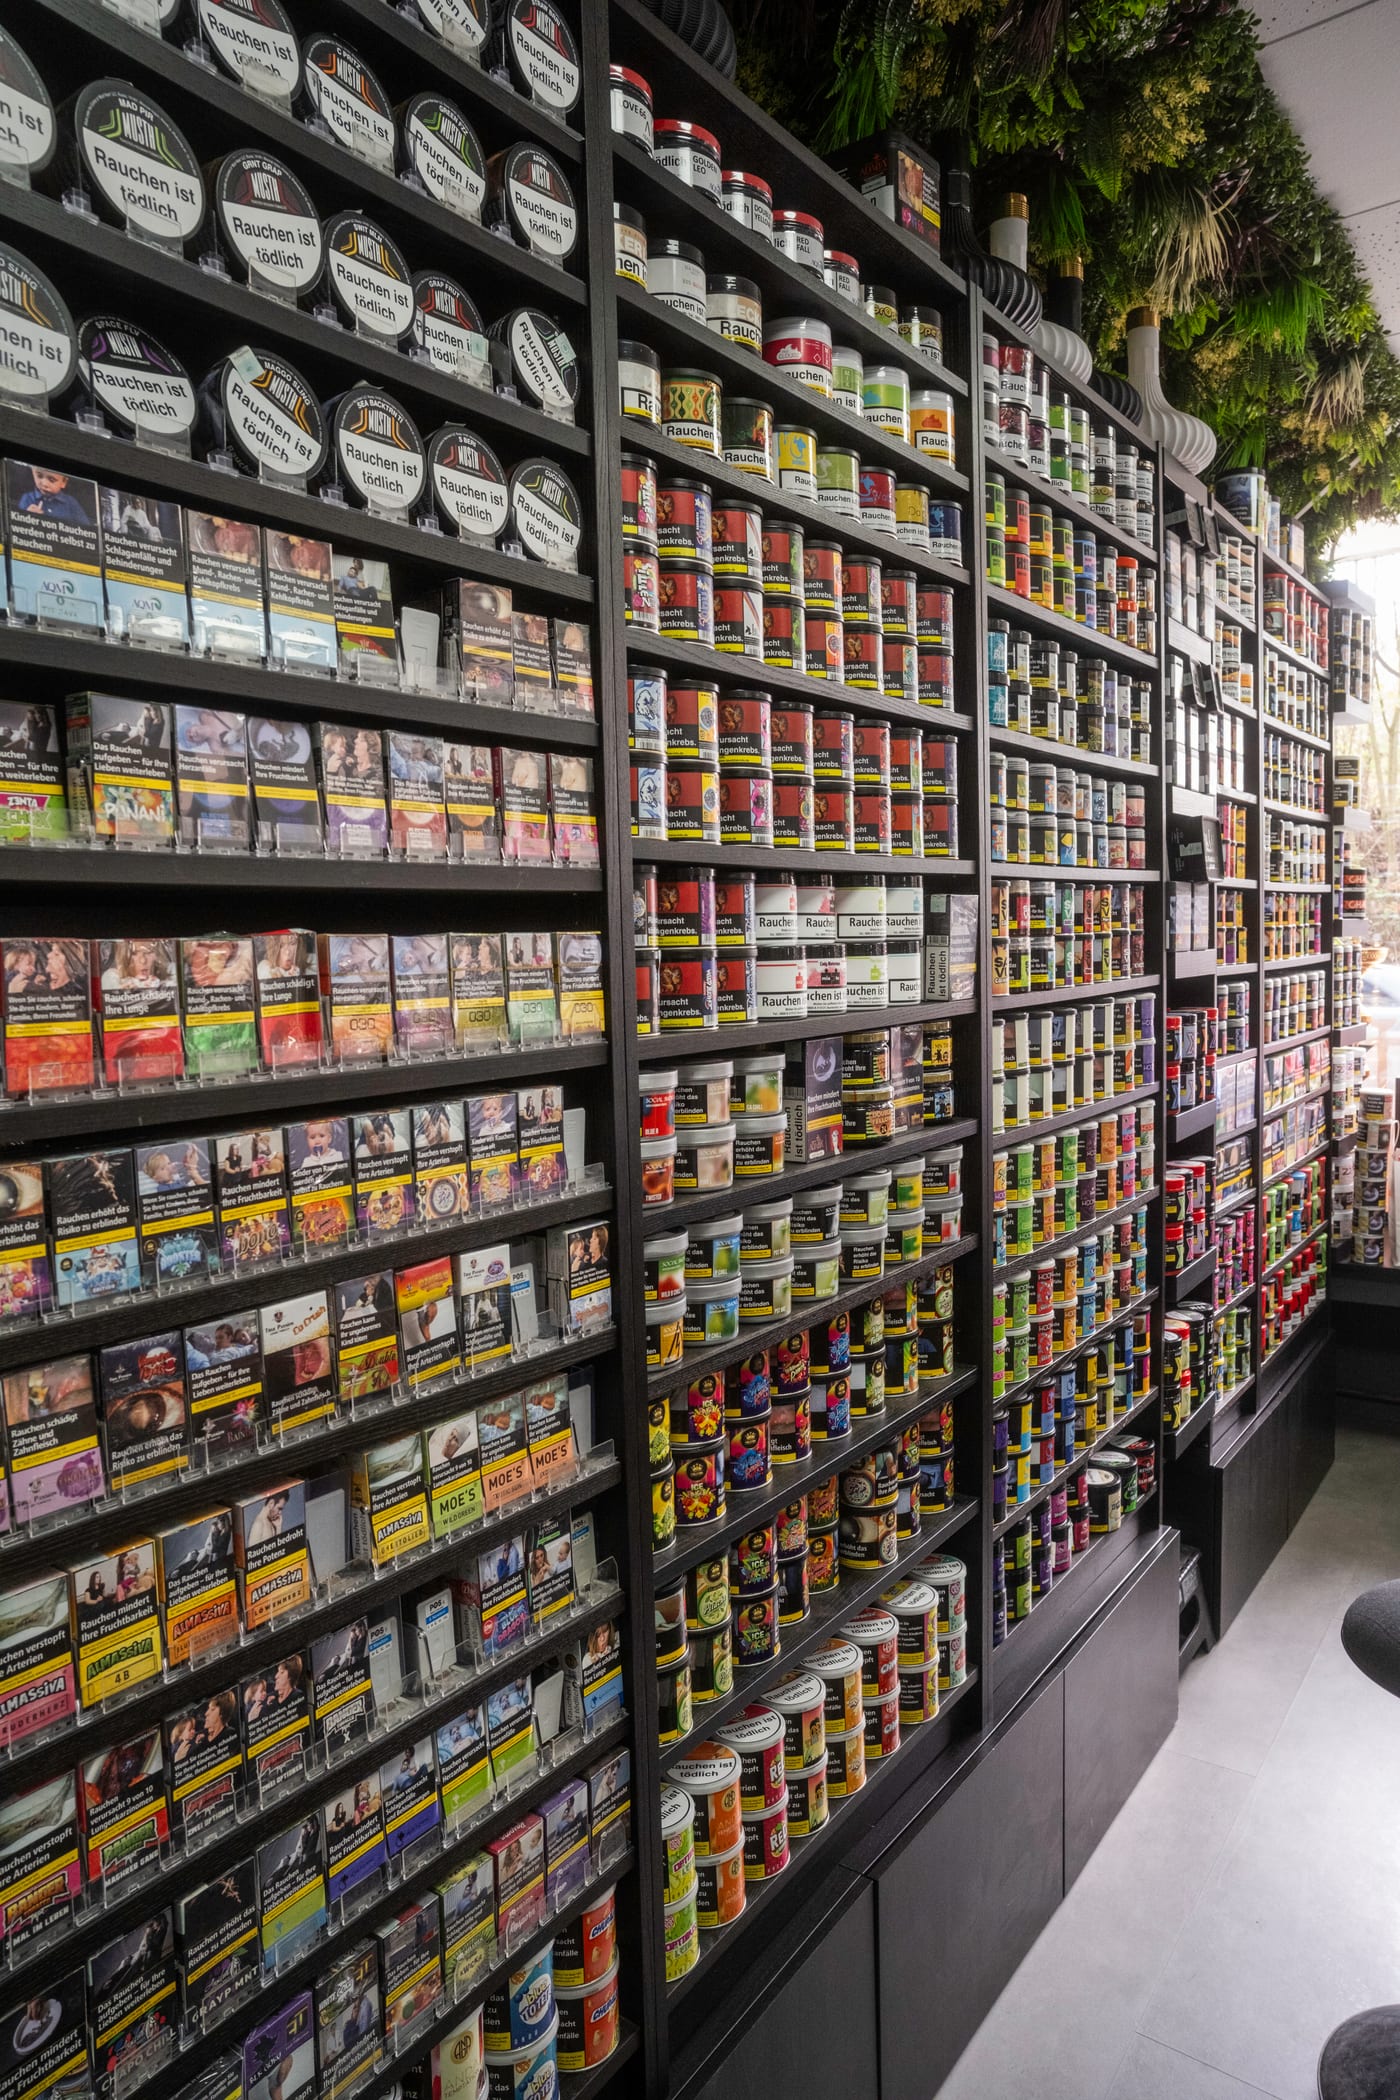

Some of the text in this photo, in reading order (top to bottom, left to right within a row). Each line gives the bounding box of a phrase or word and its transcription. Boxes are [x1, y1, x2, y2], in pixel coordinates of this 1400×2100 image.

[208, 13, 294, 62] Rauchen ist
[516, 31, 575, 88] Rauchen ist
[529, 63, 564, 97] tödlich
[118, 96, 138, 112] MAD
[18, 106, 44, 136] ist
[122, 112, 156, 150] MUSTH
[373, 122, 390, 142] ist
[416, 129, 480, 196] Rauchen ist
[692, 154, 718, 173] GOLDEN
[692, 165, 706, 175] LEO
[94, 146, 196, 206] Rauchen ist
[251, 172, 281, 202] MUSTH
[120, 184, 178, 222] tödlich
[514, 190, 572, 230] Rauchen ist
[232, 216, 316, 247] Rauchen ist
[528, 218, 562, 244] tödlich
[796, 236, 810, 246] RED
[256, 246, 304, 270] tödlich
[357, 231, 382, 264] MUSTH
[8, 263, 38, 291] SLING
[336, 262, 409, 308] Rauchen ist
[354, 294, 396, 322] tödlich
[434, 290, 456, 317] MUSTH
[96, 320, 122, 330] SPACE
[416, 320, 464, 349] Rauchen
[39, 338, 64, 364] ist
[106, 330, 143, 360] MUSTH
[519, 321, 552, 384] Rauchen
[518, 344, 546, 392] tödlich
[93, 368, 188, 398] Rauchen ist
[123, 395, 178, 418] tödlich
[268, 377, 300, 416] MUSTH
[232, 383, 292, 446] Rauchen
[296, 438, 313, 461] ist
[368, 410, 392, 437] MUSTH
[666, 426, 714, 442] Rauchen
[242, 416, 290, 464] tödlich
[346, 442, 418, 478] Rauchen ist
[458, 444, 480, 471] MUSTH
[362, 470, 404, 495] tödlich
[440, 476, 504, 508] Rauchen ist
[543, 478, 563, 506] MUSTH
[818, 494, 850, 504] Rauchen
[11, 511, 97, 539] Kinder von Rauchern
[456, 501, 492, 524] tödlich
[518, 494, 575, 546] Rauchen ist
[861, 512, 892, 522] Rauchen
[12, 524, 96, 550] werden oft selbst zu
[12, 536, 52, 552] Rauchern
[104, 534, 177, 557] Rauchen verursacht
[105, 545, 156, 565] Schlaganfälle
[157, 556, 172, 566] und
[106, 556, 164, 577] Behinderungen
[192, 554, 256, 576] Rauchen verursacht
[93, 741, 142, 756] Das Rauchen
[94, 752, 169, 769] aufgeben für Ihre
[94, 764, 166, 778] Lieben weiterleben
[759, 916, 794, 929] Rauchen
[849, 916, 883, 928] Rauchen
[927, 952, 936, 994] Rauchen
[939, 950, 948, 996] ist tödlich
[104, 990, 175, 1002] Rauchen schädigt
[762, 996, 802, 1008] Rauchen
[830, 990, 842, 1002] ist
[104, 1004, 150, 1015] Ihre Lunge
[794, 1104, 803, 1144] tödlich
[358, 1154, 409, 1172] Rauchen verstopft
[358, 1166, 394, 1180] Ihre Arterien
[221, 1178, 280, 1196] Rauchen mindert
[222, 1188, 283, 1206] Ihre Fruchtbarkeit
[56, 1204, 130, 1226] Rauchen erhöht das
[58, 1224, 80, 1236] Risiko
[80, 1223, 91, 1232] zu
[92, 1216, 128, 1230] erblinden
[11, 1412, 78, 1438] Rauchen schädigt
[12, 1430, 54, 1448] Zähne und
[13, 1437, 59, 1457] Zahnfleisch
[535, 1442, 568, 1466] MOE'S
[488, 1466, 523, 1490] MOE'S
[439, 1487, 477, 1516] MOE'S
[247, 1528, 304, 1560] Rauchen bedroht
[248, 1548, 286, 1571] Ihre Potenz
[80, 1613, 116, 1632] Rauchen
[116, 1596, 150, 1619] mindert
[82, 1630, 99, 1644] Ihre
[100, 1606, 153, 1636] Fruchtbarkeit
[26, 1630, 66, 1654] verstopft
[369, 1627, 385, 1640] POS
[5, 1652, 44, 1676] Arterien
[818, 1654, 850, 1670] tödlich
[114, 1670, 130, 1684] 4 B
[766, 1676, 813, 1702] Rauchen ist
[717, 1713, 778, 1738] Rauchen ist
[735, 1726, 772, 1741] tödlich
[680, 1770, 720, 1779] tödlich
[717, 1760, 734, 1769] ist
[30, 1827, 73, 1852] verstopft
[40, 2028, 80, 2058] mindert
